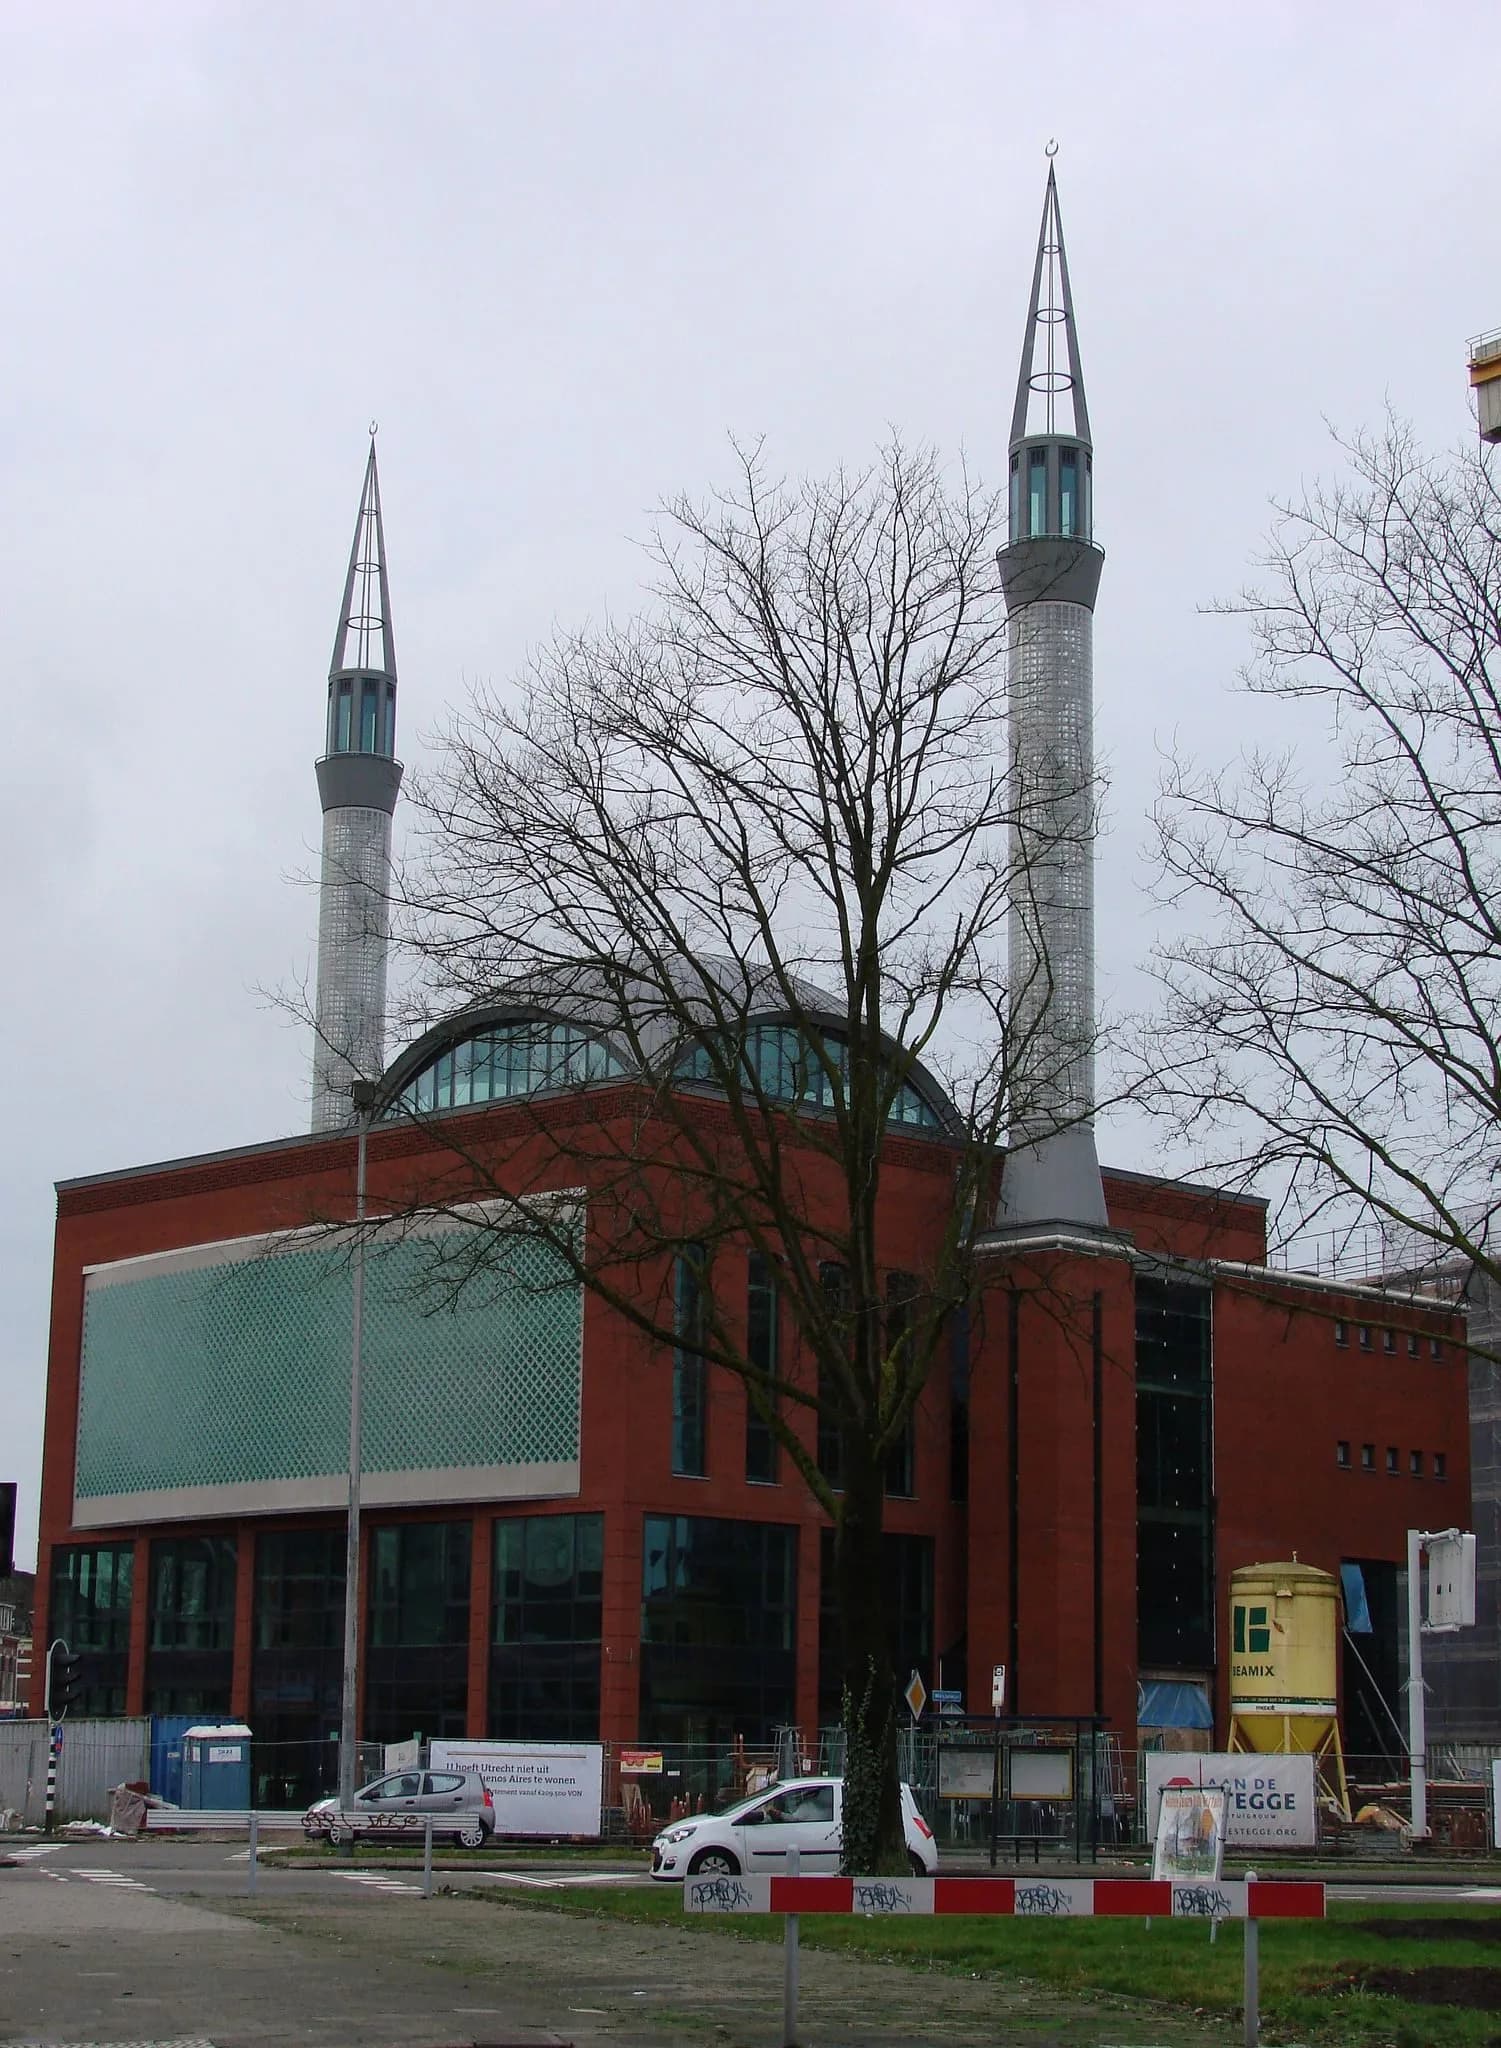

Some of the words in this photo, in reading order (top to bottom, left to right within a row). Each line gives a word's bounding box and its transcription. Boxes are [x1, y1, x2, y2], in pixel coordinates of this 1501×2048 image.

[481, 1763, 514, 1773] Utrecht
[516, 1764, 535, 1773] niet
[536, 1765, 549, 1774] uit
[508, 1774, 532, 1784] Aires
[533, 1775, 543, 1784] te
[544, 1776, 576, 1785] wonen
[1254, 1778, 1277, 1790] DE
[567, 1789, 583, 1797] VON
